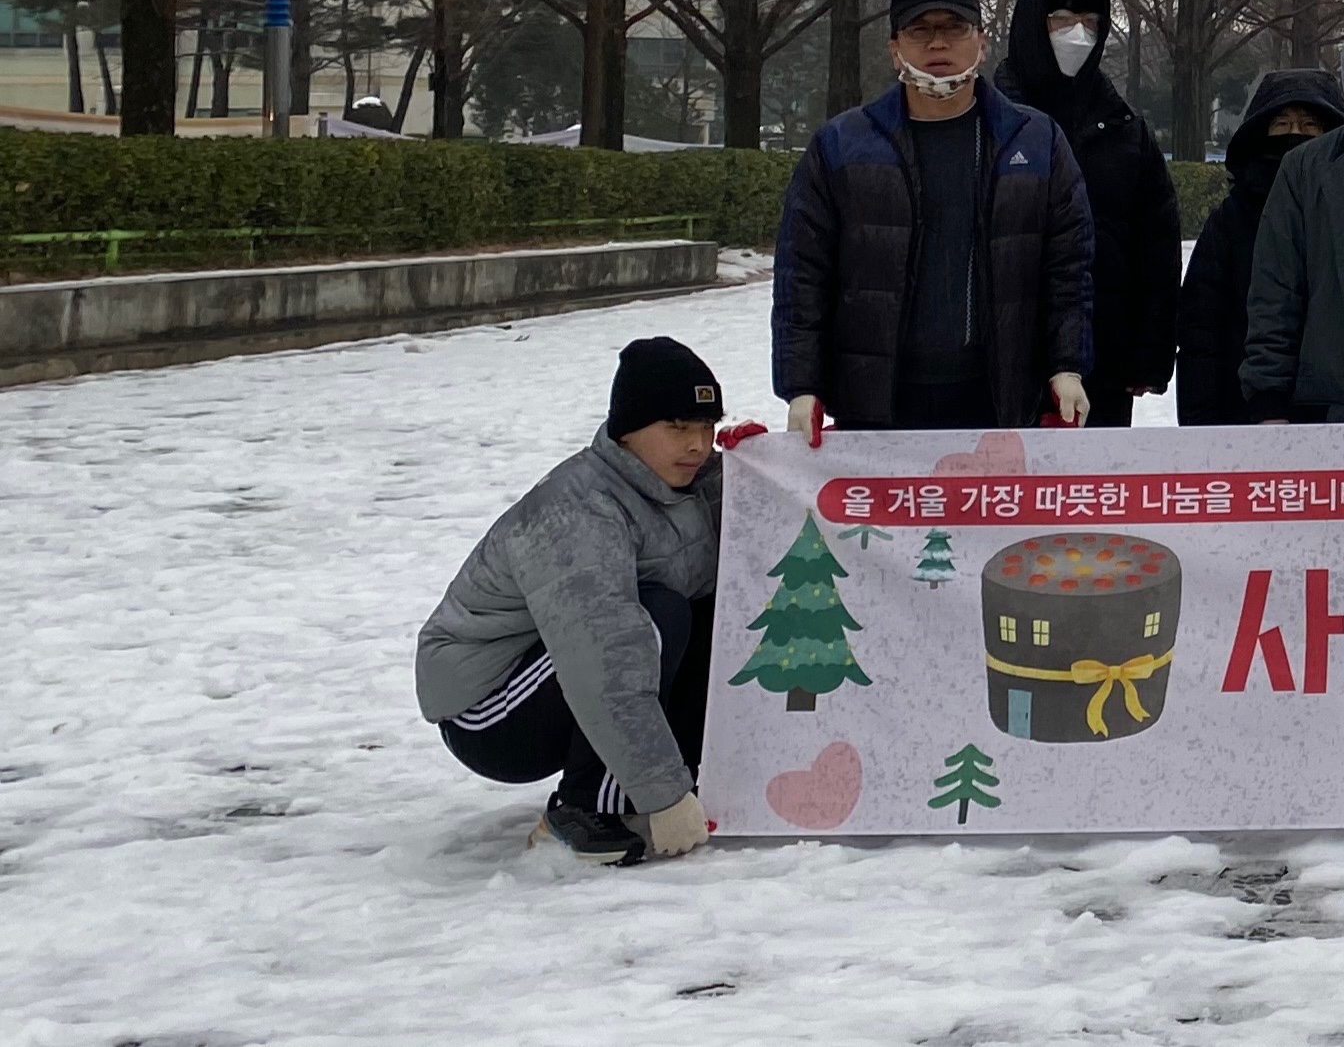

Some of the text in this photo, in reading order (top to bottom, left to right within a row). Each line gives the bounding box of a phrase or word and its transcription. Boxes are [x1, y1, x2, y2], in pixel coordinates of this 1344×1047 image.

[841, 487, 876, 518] 올
[887, 485, 947, 518] 겨울
[961, 485, 1024, 517] 가장
[1036, 483, 1130, 517] 따뜻한
[1142, 482, 1234, 515] 나눔을
